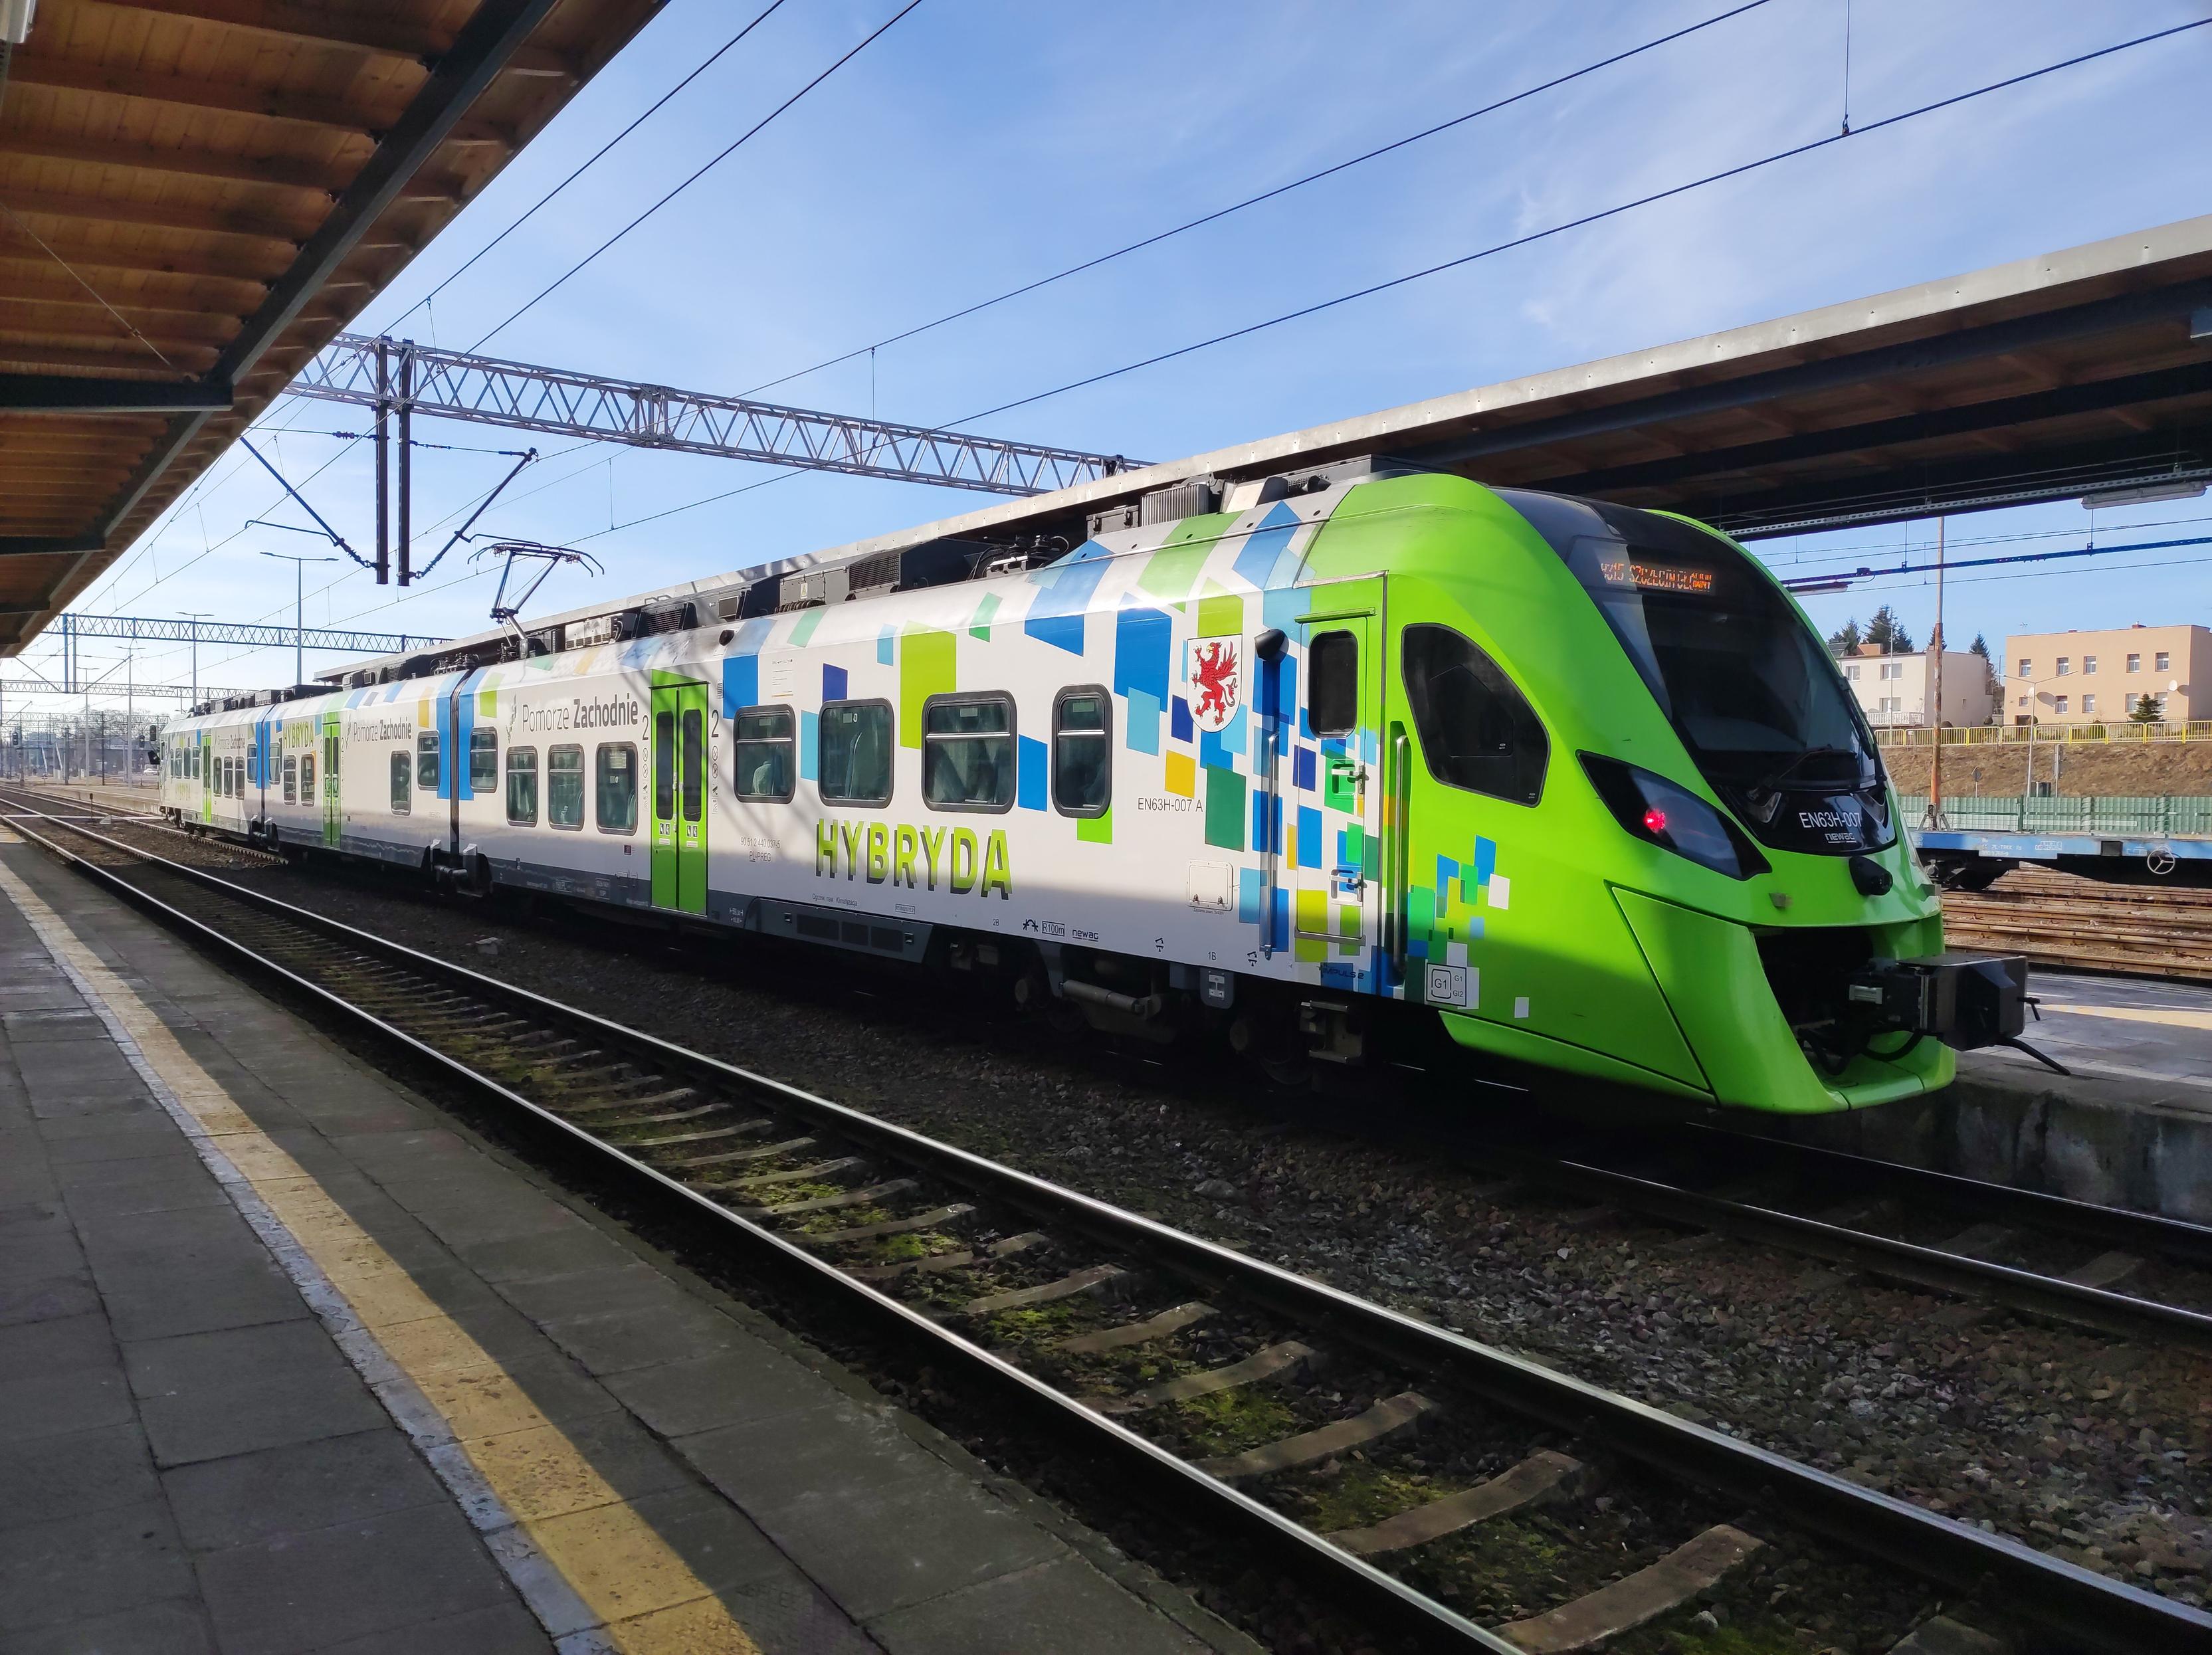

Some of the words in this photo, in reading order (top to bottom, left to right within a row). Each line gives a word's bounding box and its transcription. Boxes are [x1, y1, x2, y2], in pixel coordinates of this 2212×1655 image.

[522, 704, 569, 732] Pomorze
[573, 692, 638, 729] Zachodnie
[353, 722, 378, 742] Pomorze
[379, 716, 411, 740] Zachodnie
[642, 715, 649, 740] 2
[711, 710, 719, 737] 2
[283, 721, 314, 749] HYBRYDA
[1138, 797, 1192, 811] EN63H-007
[1195, 799, 1203, 812] A
[1799, 812, 1862, 828] EN63H-007
[750, 851, 771, 862] PL-PREG
[816, 818, 1013, 900] HYBRYDA
[1042, 922, 1064, 935] R100m
[1072, 929, 1099, 941] newag
[1208, 951, 1217, 961] 1B
[1435, 978, 1447, 989] G1
